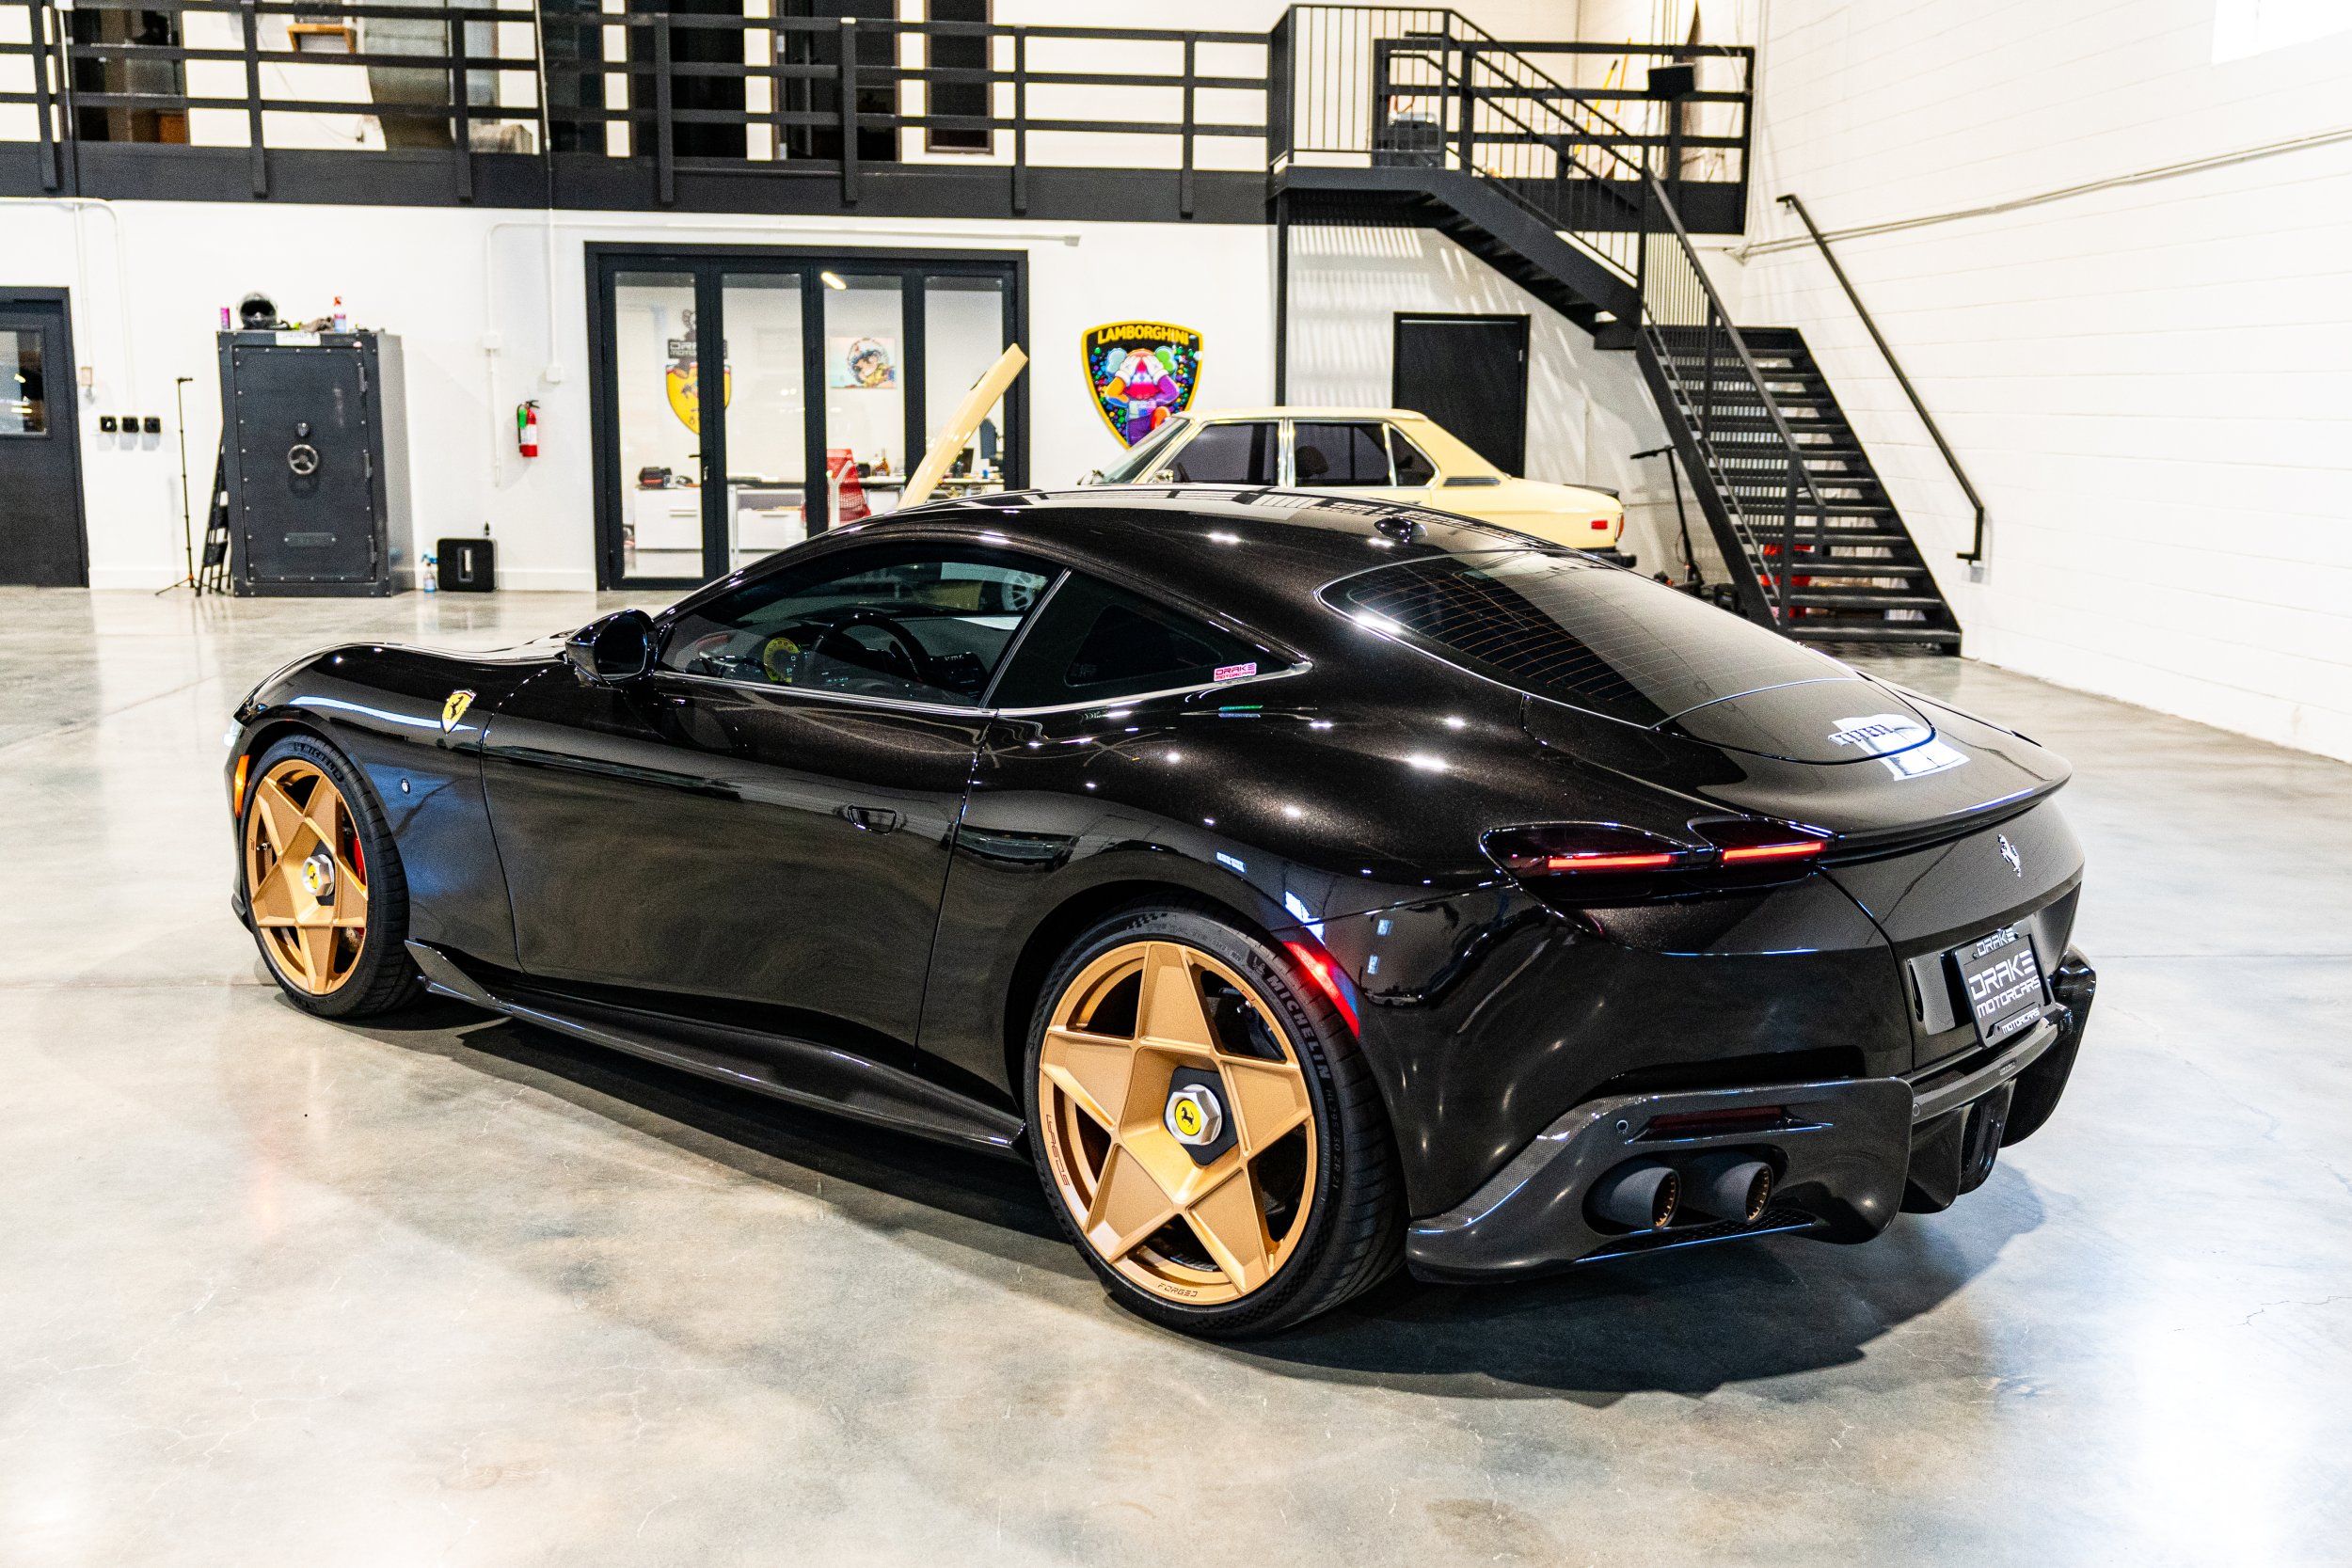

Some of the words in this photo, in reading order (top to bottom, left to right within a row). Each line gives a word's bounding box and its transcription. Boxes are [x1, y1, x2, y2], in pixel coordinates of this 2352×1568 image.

[1097, 325, 1190, 345] LAMBORGHINI
[1216, 664, 1255, 675] DRAKE
[1977, 927, 2015, 957] DRAKE
[1968, 949, 2037, 1000] DRAKE
[1977, 974, 2042, 1019] MOTORCARS
[1266, 974, 1331, 1079] MICHELIN
[2002, 1007, 2041, 1034] MOTORCARS
[1158, 1282, 1198, 1297] FORGED
